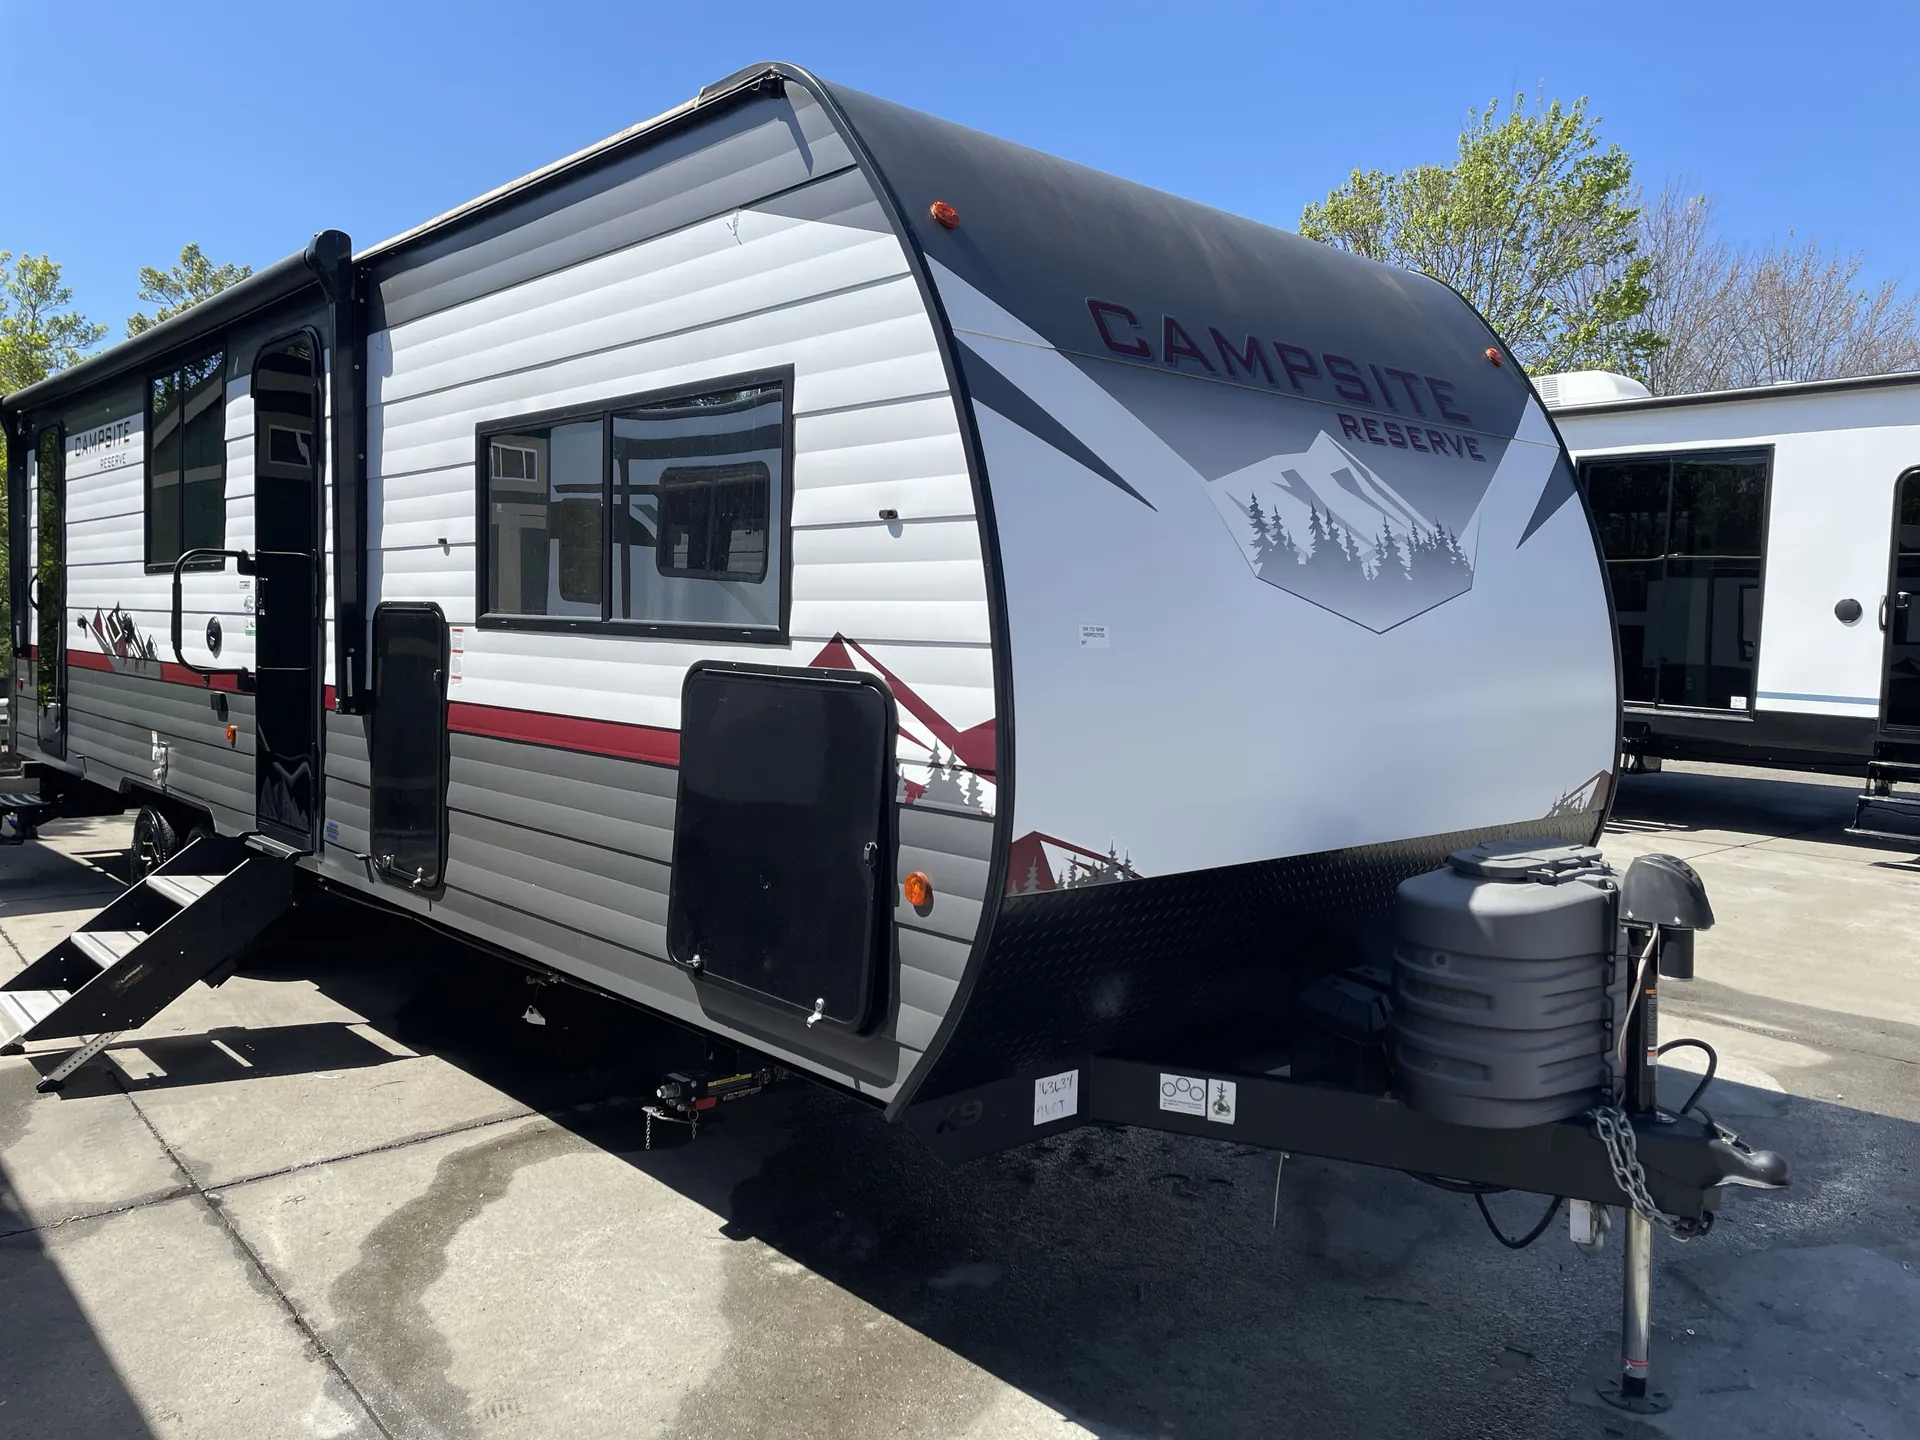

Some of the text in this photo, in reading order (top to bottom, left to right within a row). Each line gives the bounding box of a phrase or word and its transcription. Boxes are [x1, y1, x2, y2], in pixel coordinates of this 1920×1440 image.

[1085, 296, 1471, 424] CAMPSITE
[75, 421, 131, 457] CAMPSITE
[1337, 412, 1486, 462] RESERVE
[100, 453, 126, 470] RESERVE
